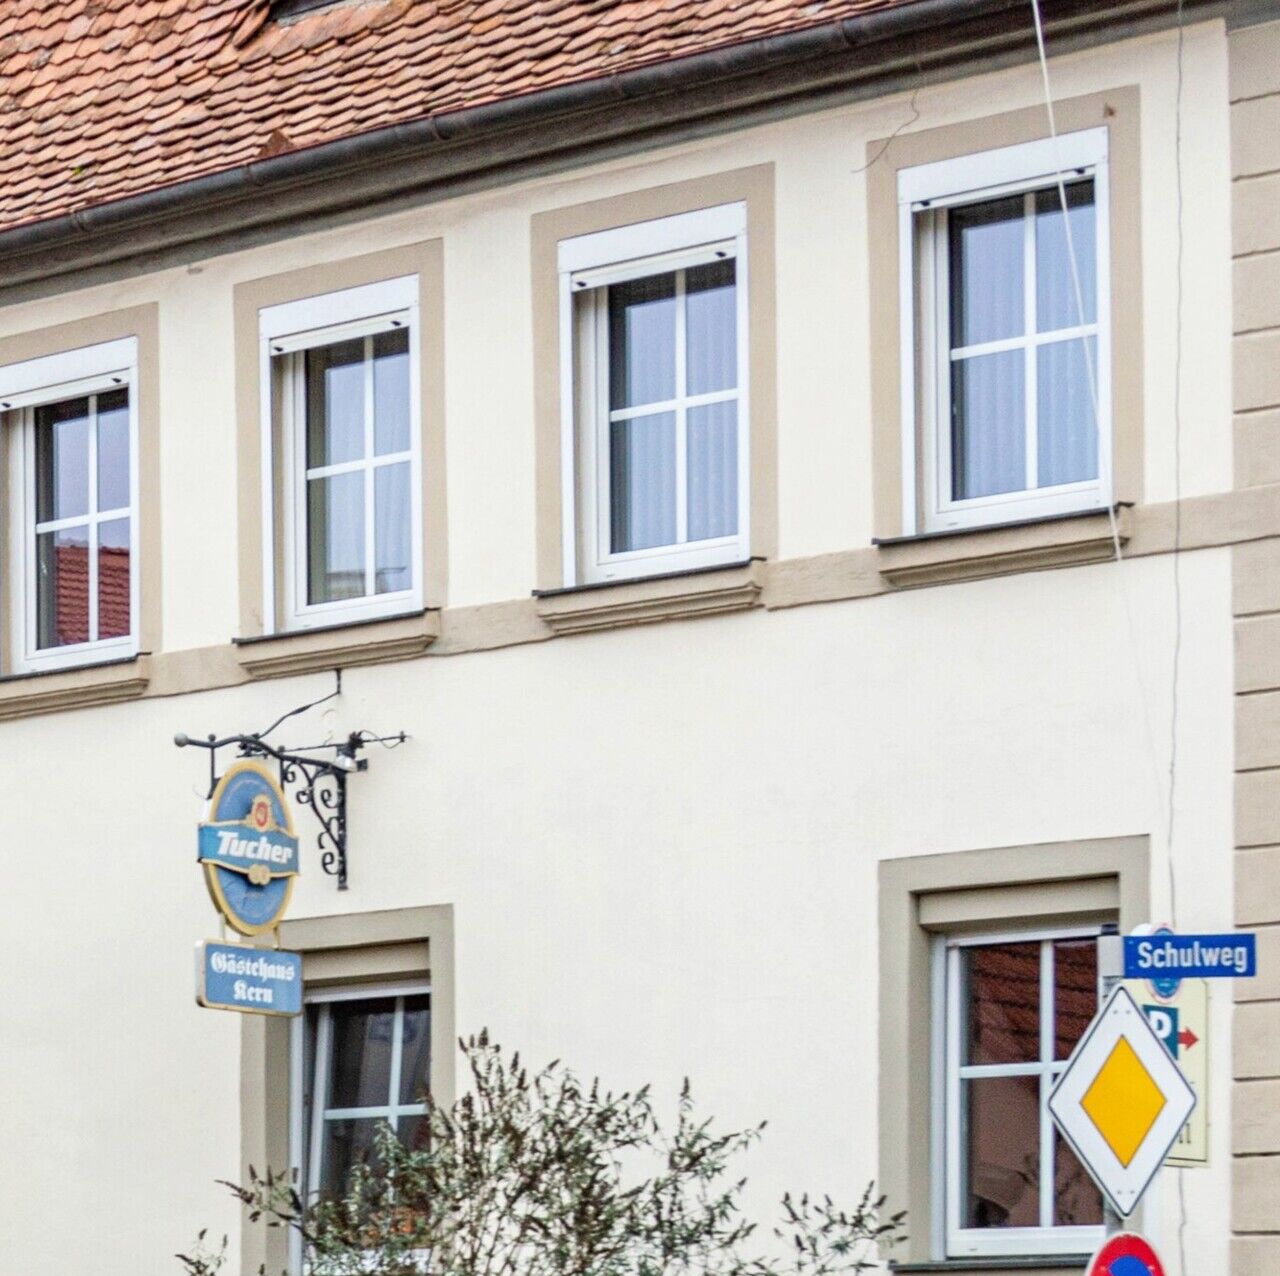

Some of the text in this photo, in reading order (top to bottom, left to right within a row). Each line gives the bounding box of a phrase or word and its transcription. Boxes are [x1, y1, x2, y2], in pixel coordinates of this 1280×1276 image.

[217, 831, 293, 864] Tucher
[211, 951, 295, 983] Gästehaus
[1138, 941, 1248, 973] Schulweg
[233, 981, 273, 1004] Kern
